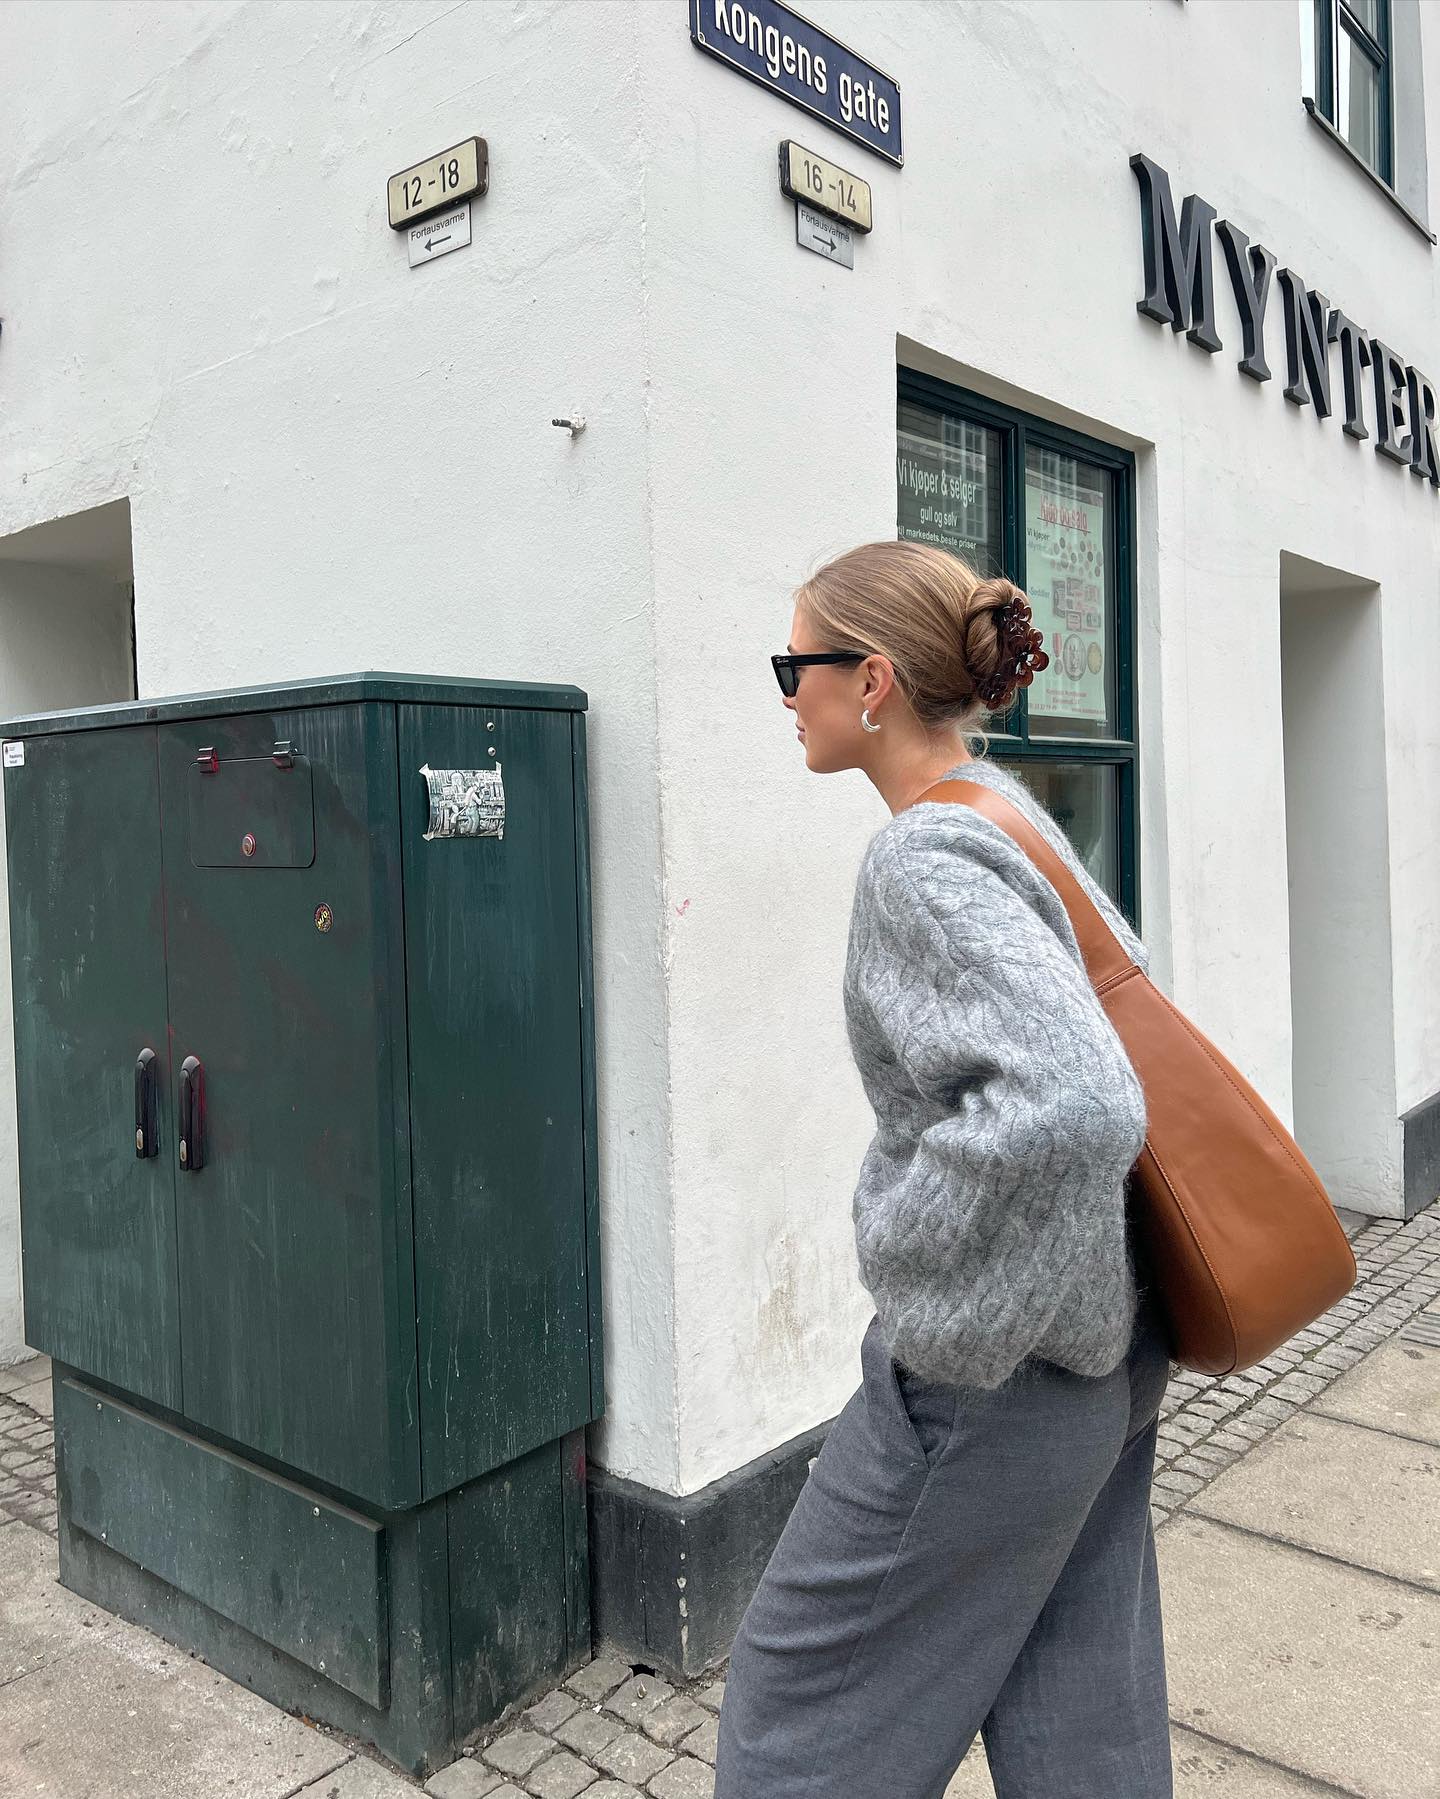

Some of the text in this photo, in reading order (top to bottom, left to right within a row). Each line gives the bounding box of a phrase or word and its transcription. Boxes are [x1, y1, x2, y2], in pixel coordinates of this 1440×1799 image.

[715, 0, 890, 134] Kongens gate
[410, 211, 466, 241] Fortausvarme
[800, 209, 850, 243] Fortausvarme
[1129, 152, 1440, 488] MYNTER
[897, 456, 977, 508] Vi kjøper & selger
[920, 505, 958, 528] gull og sølv
[906, 528, 940, 543] markedets
[940, 533, 958, 547] beste
[958, 538, 977, 551] priser
